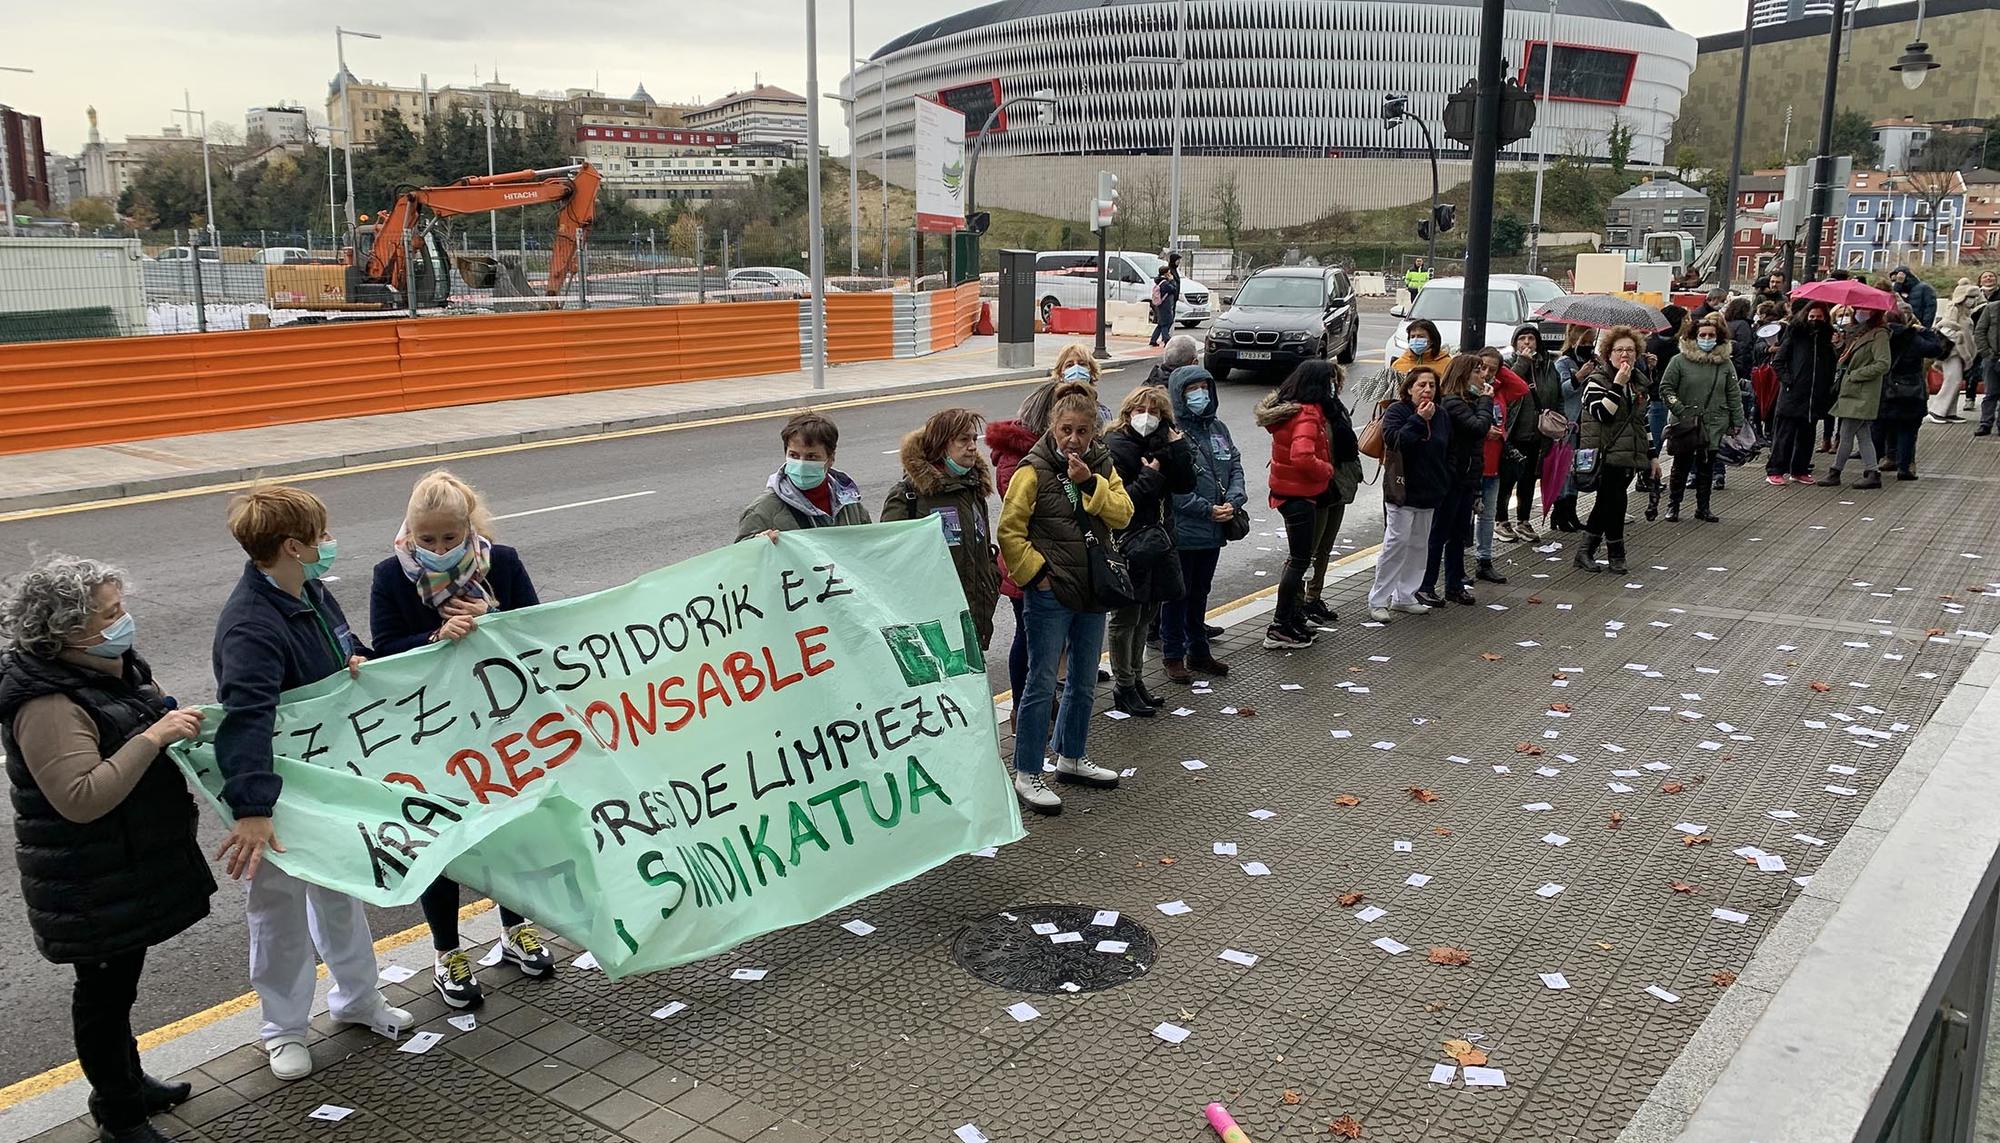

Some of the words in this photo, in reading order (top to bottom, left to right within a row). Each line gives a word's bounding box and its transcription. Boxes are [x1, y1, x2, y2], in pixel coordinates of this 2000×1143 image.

[504, 191, 538, 200] HITACHI
[781, 563, 853, 612] EZ
[746, 693, 968, 799] LIMPIEZA
[637, 756, 953, 919] SINDIKATUA
